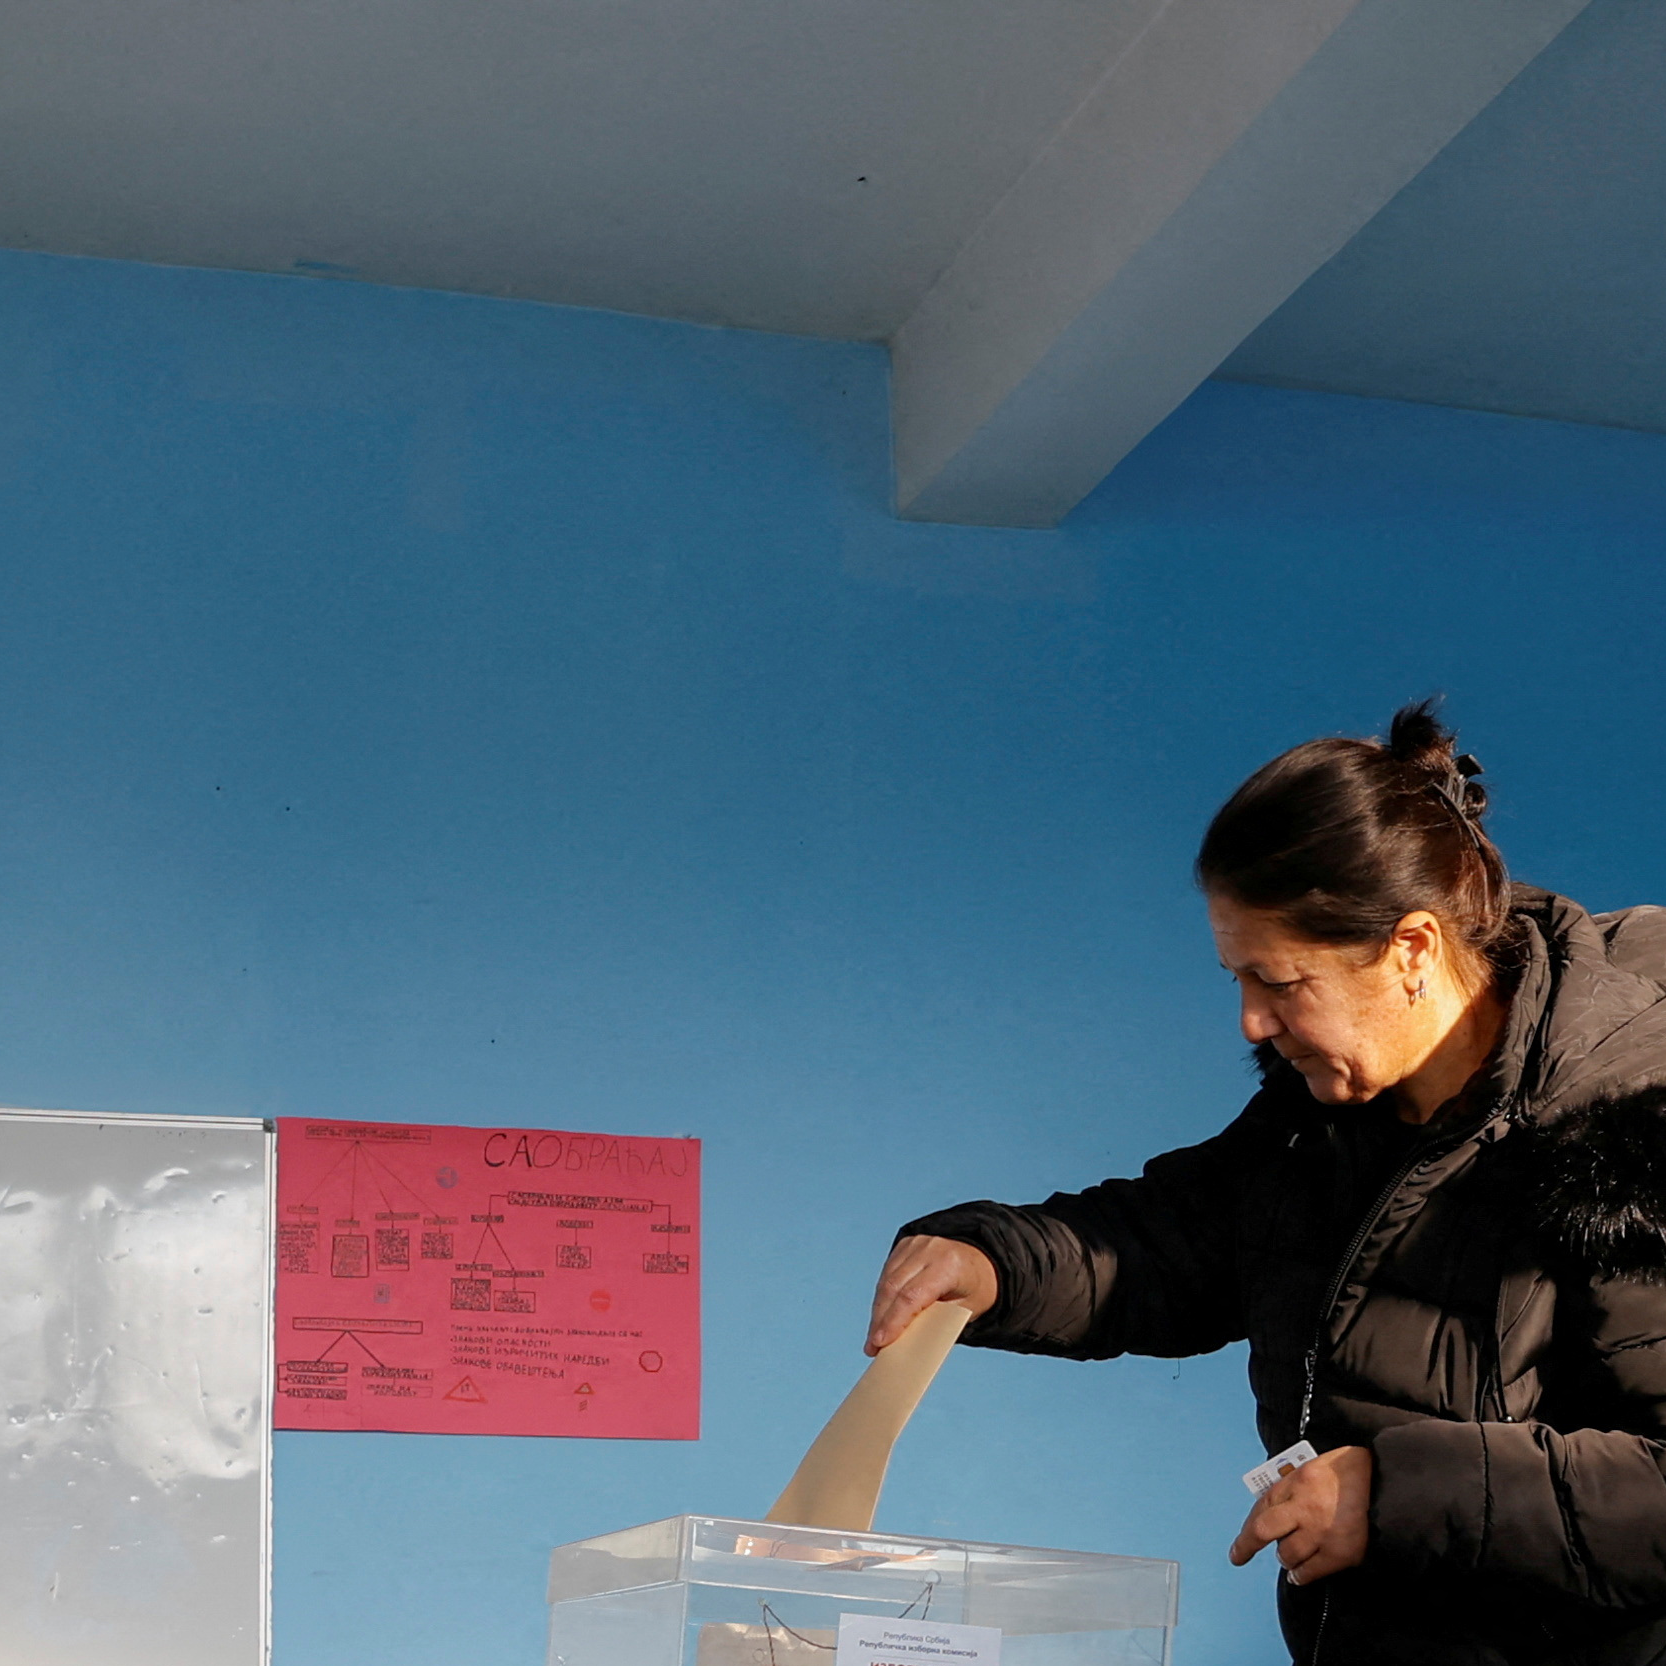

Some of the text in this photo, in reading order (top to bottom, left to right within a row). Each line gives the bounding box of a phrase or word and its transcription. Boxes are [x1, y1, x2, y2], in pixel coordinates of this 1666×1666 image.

[483, 1132, 689, 1178] САОБРАЋАЈ
[883, 1631, 951, 1646] Република Србија
[859, 1639, 978, 1659] Републичка изборна комисија
